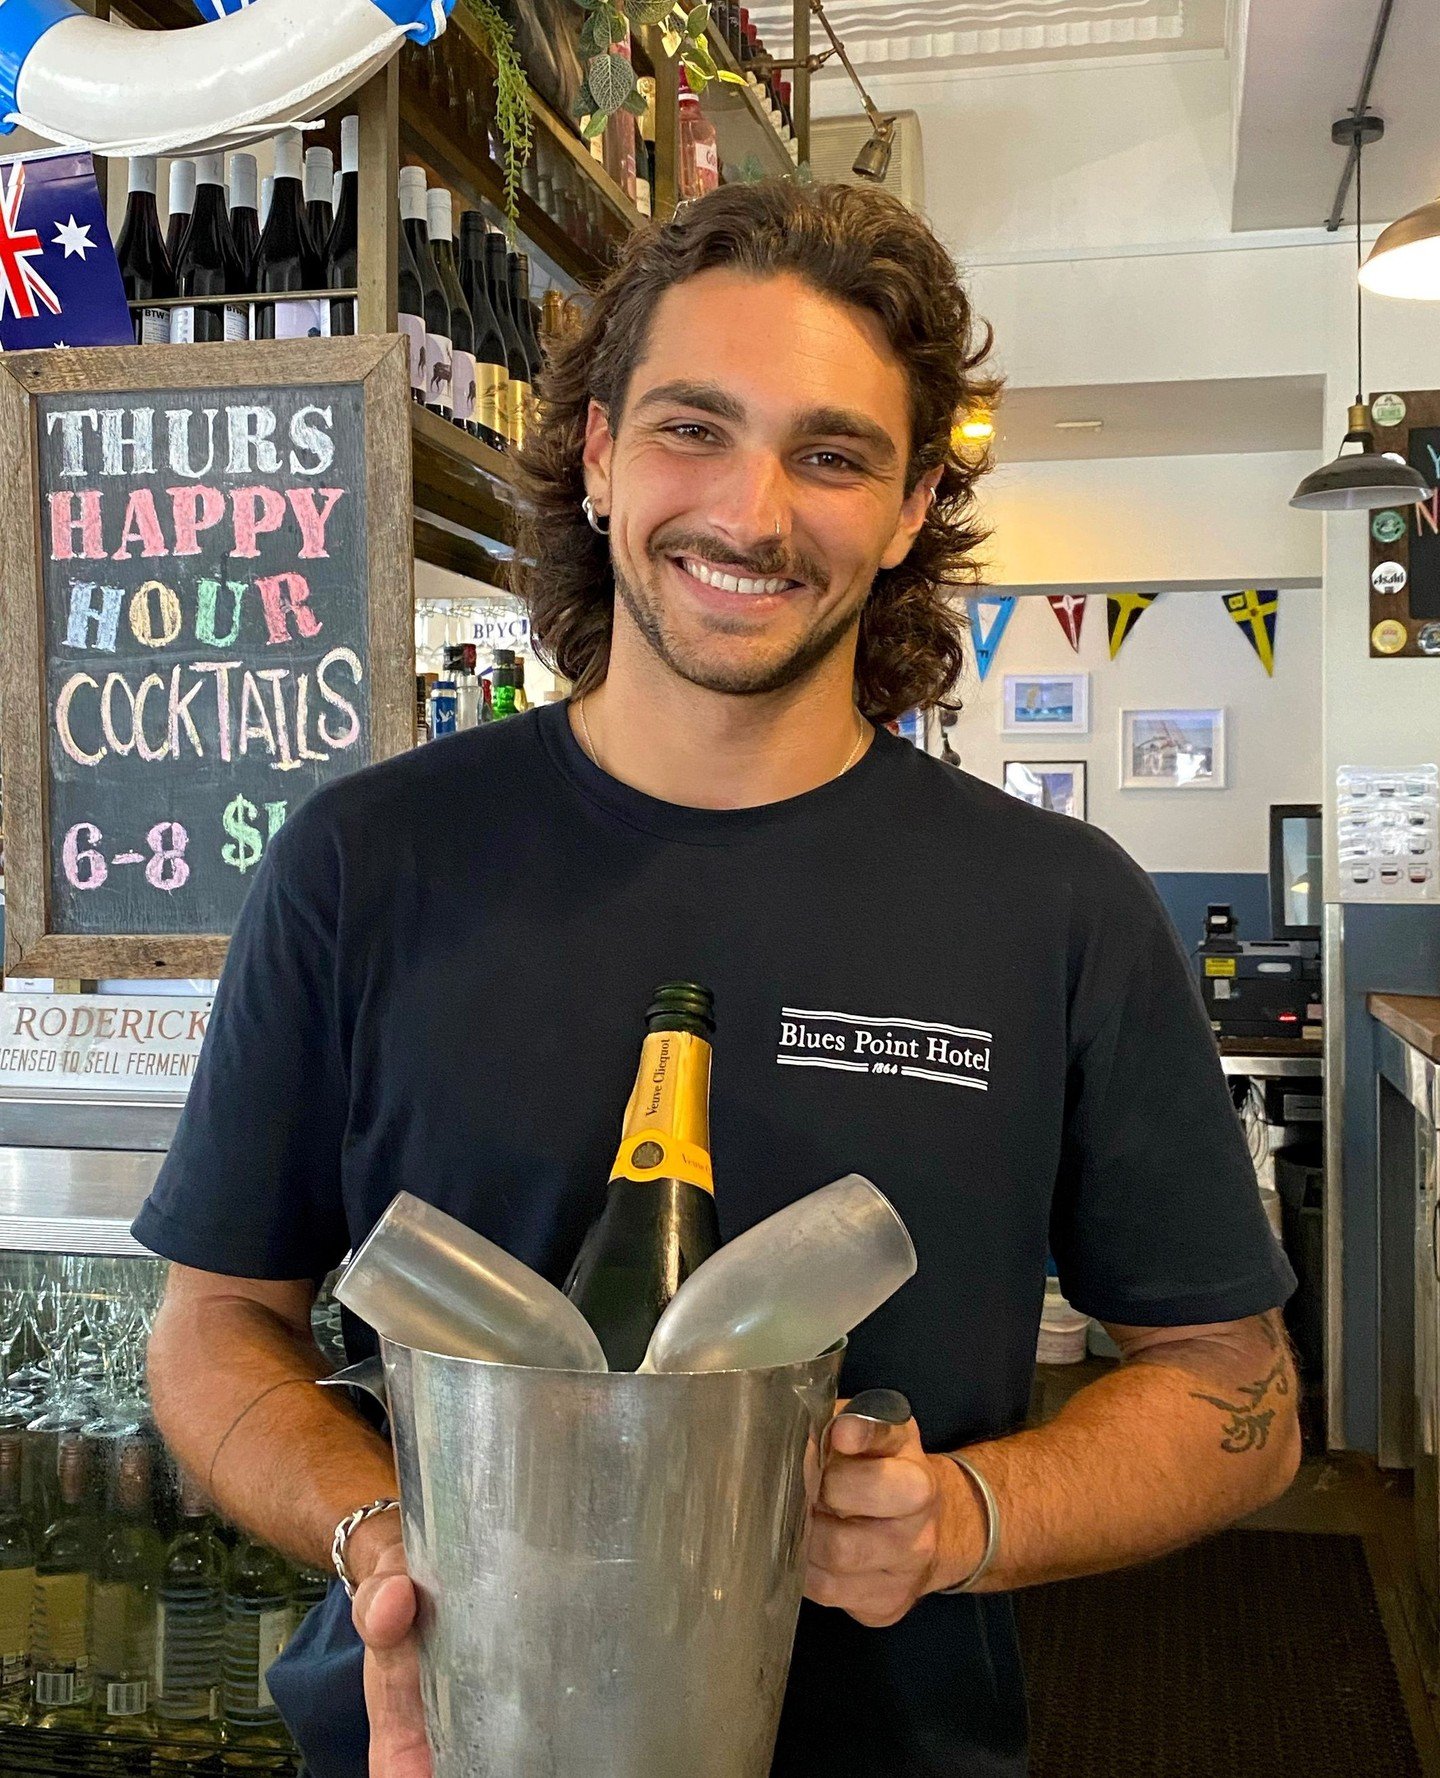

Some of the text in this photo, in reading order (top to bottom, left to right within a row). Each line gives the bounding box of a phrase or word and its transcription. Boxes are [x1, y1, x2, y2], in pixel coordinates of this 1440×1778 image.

[145, 309, 165, 320] BTW
[46, 403, 335, 478] THURS
[46, 484, 345, 560] HAPPY
[61, 571, 323, 652] HOUR
[56, 647, 363, 772] COCKTAILS
[62, 821, 191, 891] 6-8
[13, 1006, 209, 1044] RODERICK
[779, 1022, 990, 1072] Blues Point Hotel
[0, 1048, 57, 1072] CENSED
[62, 1050, 80, 1073] TO
[85, 1051, 120, 1074] SELL
[645, 1038, 671, 1117] Veuve Clicquot
[871, 1062, 898, 1075] 1864
